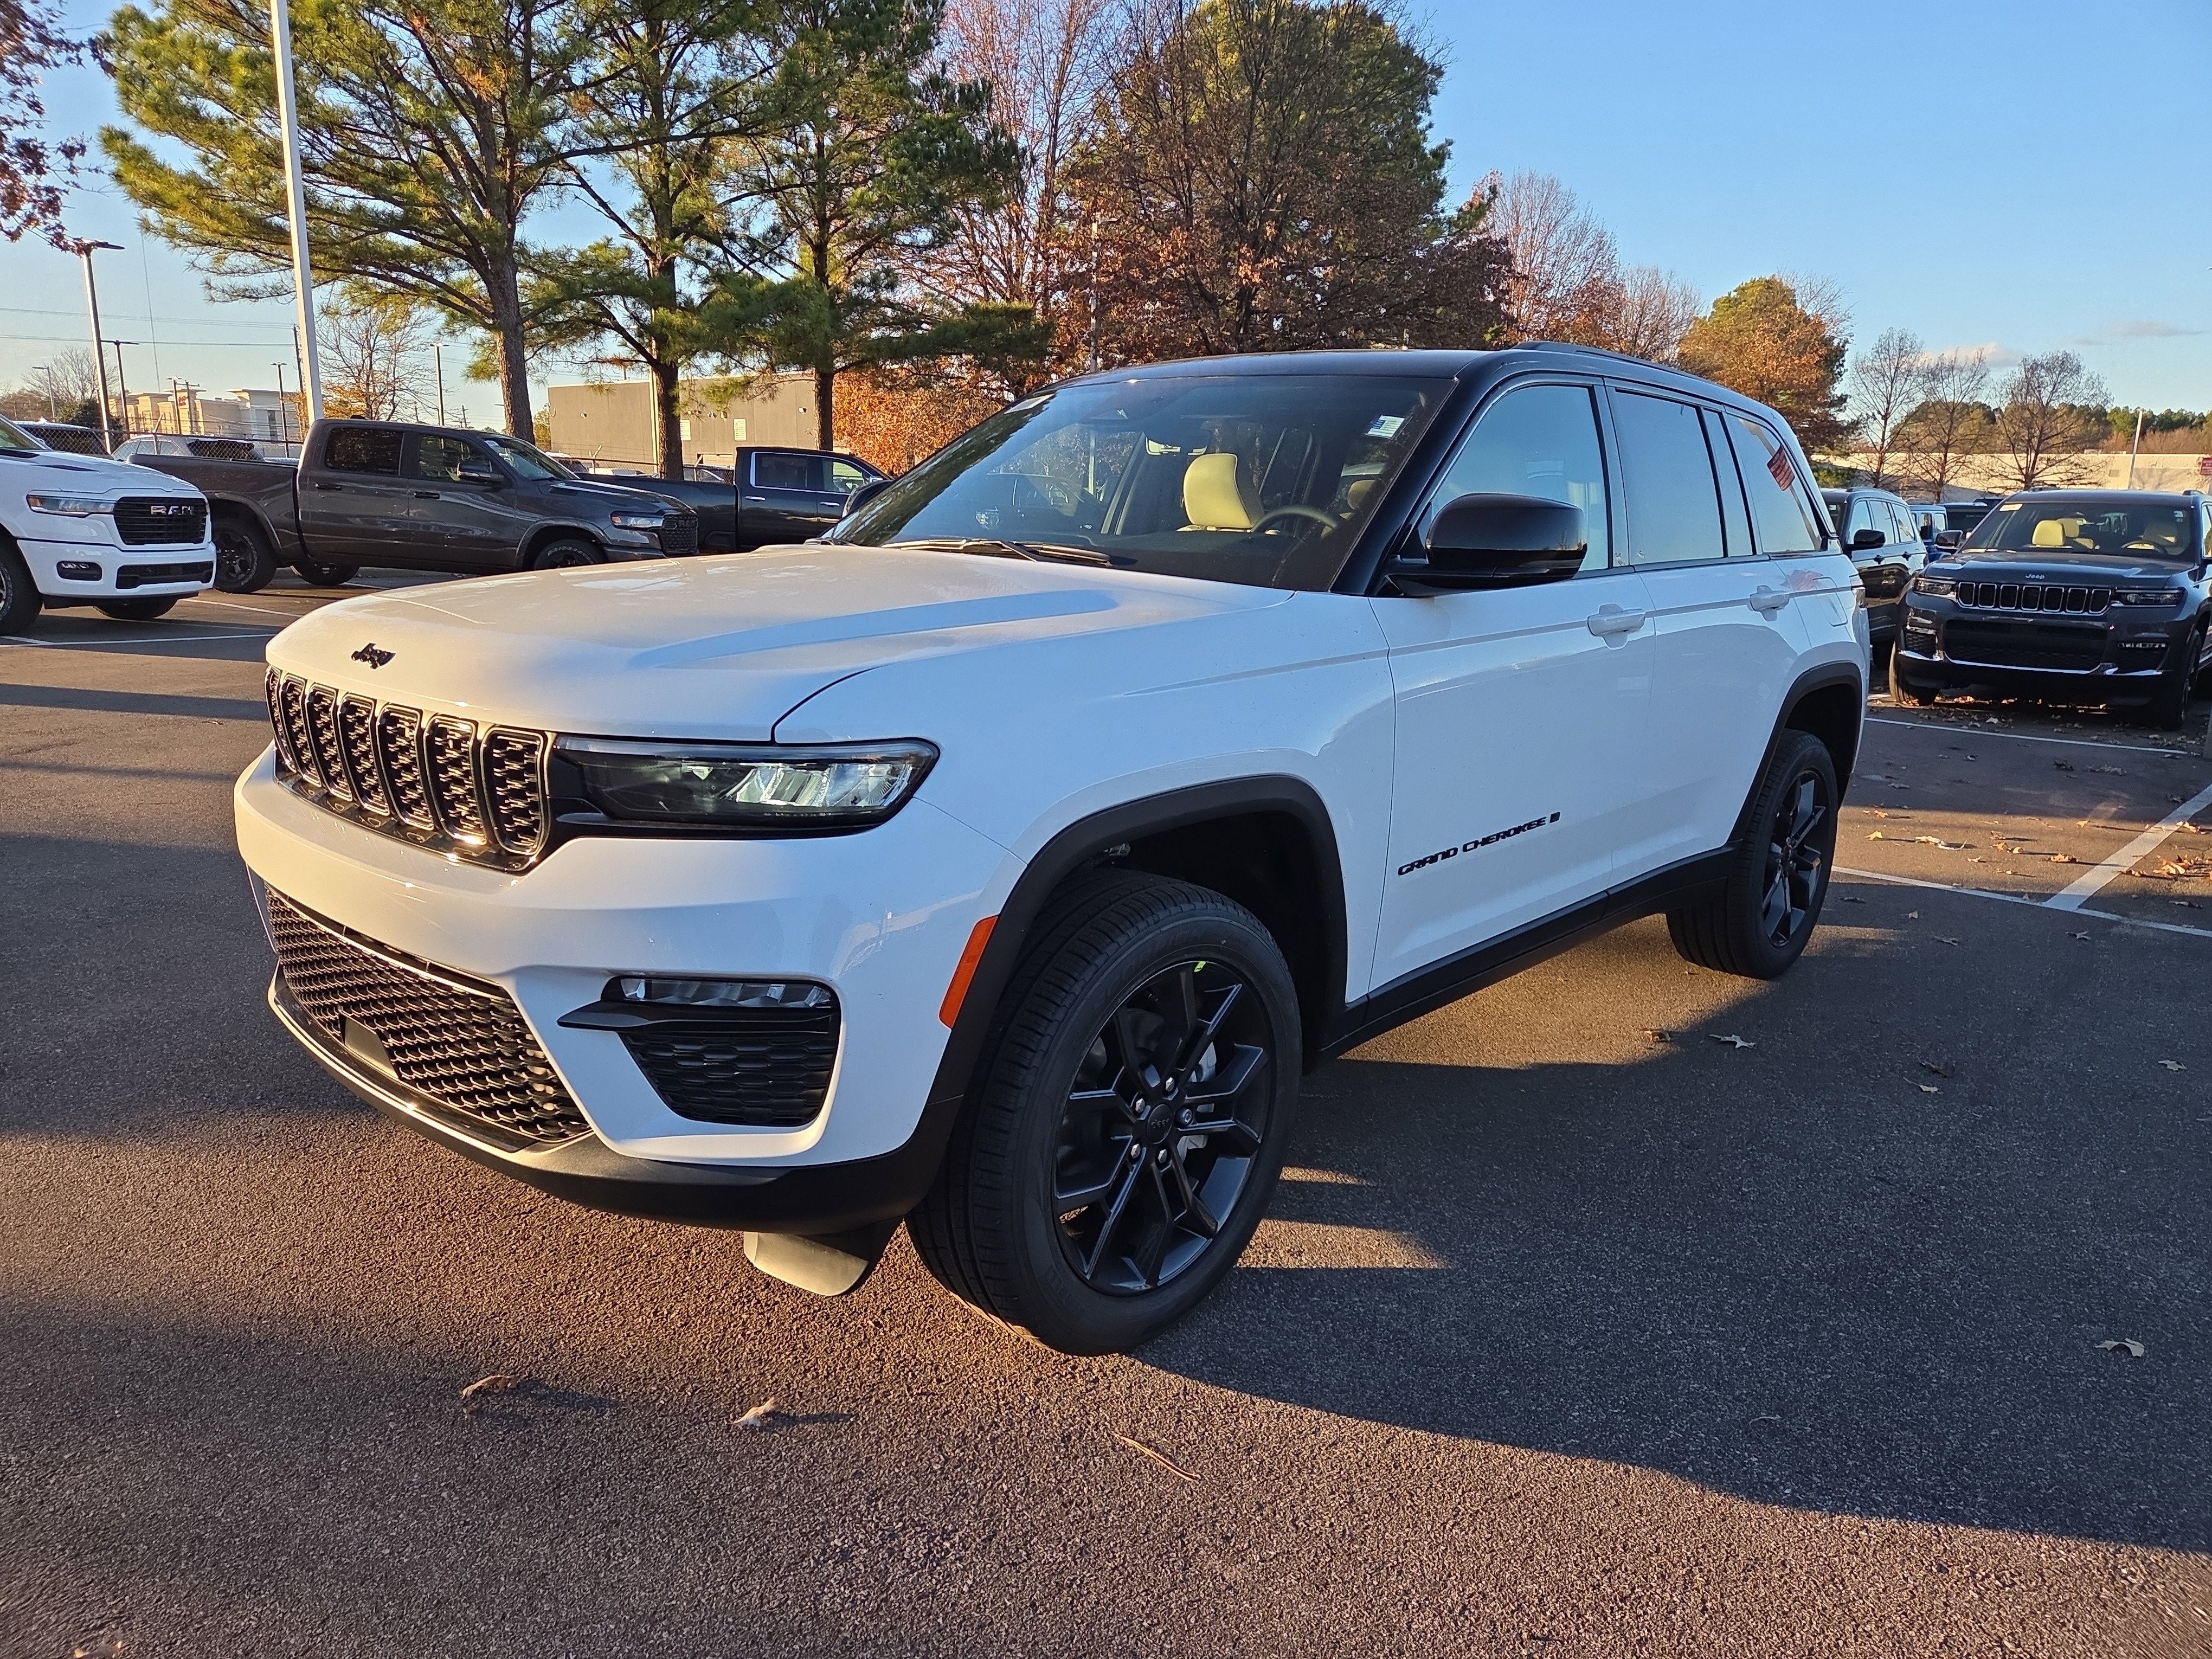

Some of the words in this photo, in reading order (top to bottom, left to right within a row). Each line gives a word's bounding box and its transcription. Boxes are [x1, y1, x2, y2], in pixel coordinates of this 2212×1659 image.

[151, 505, 195, 516] RAM
[1398, 847, 1458, 876] GRAND
[1462, 816, 1547, 852] CHEROKEE
